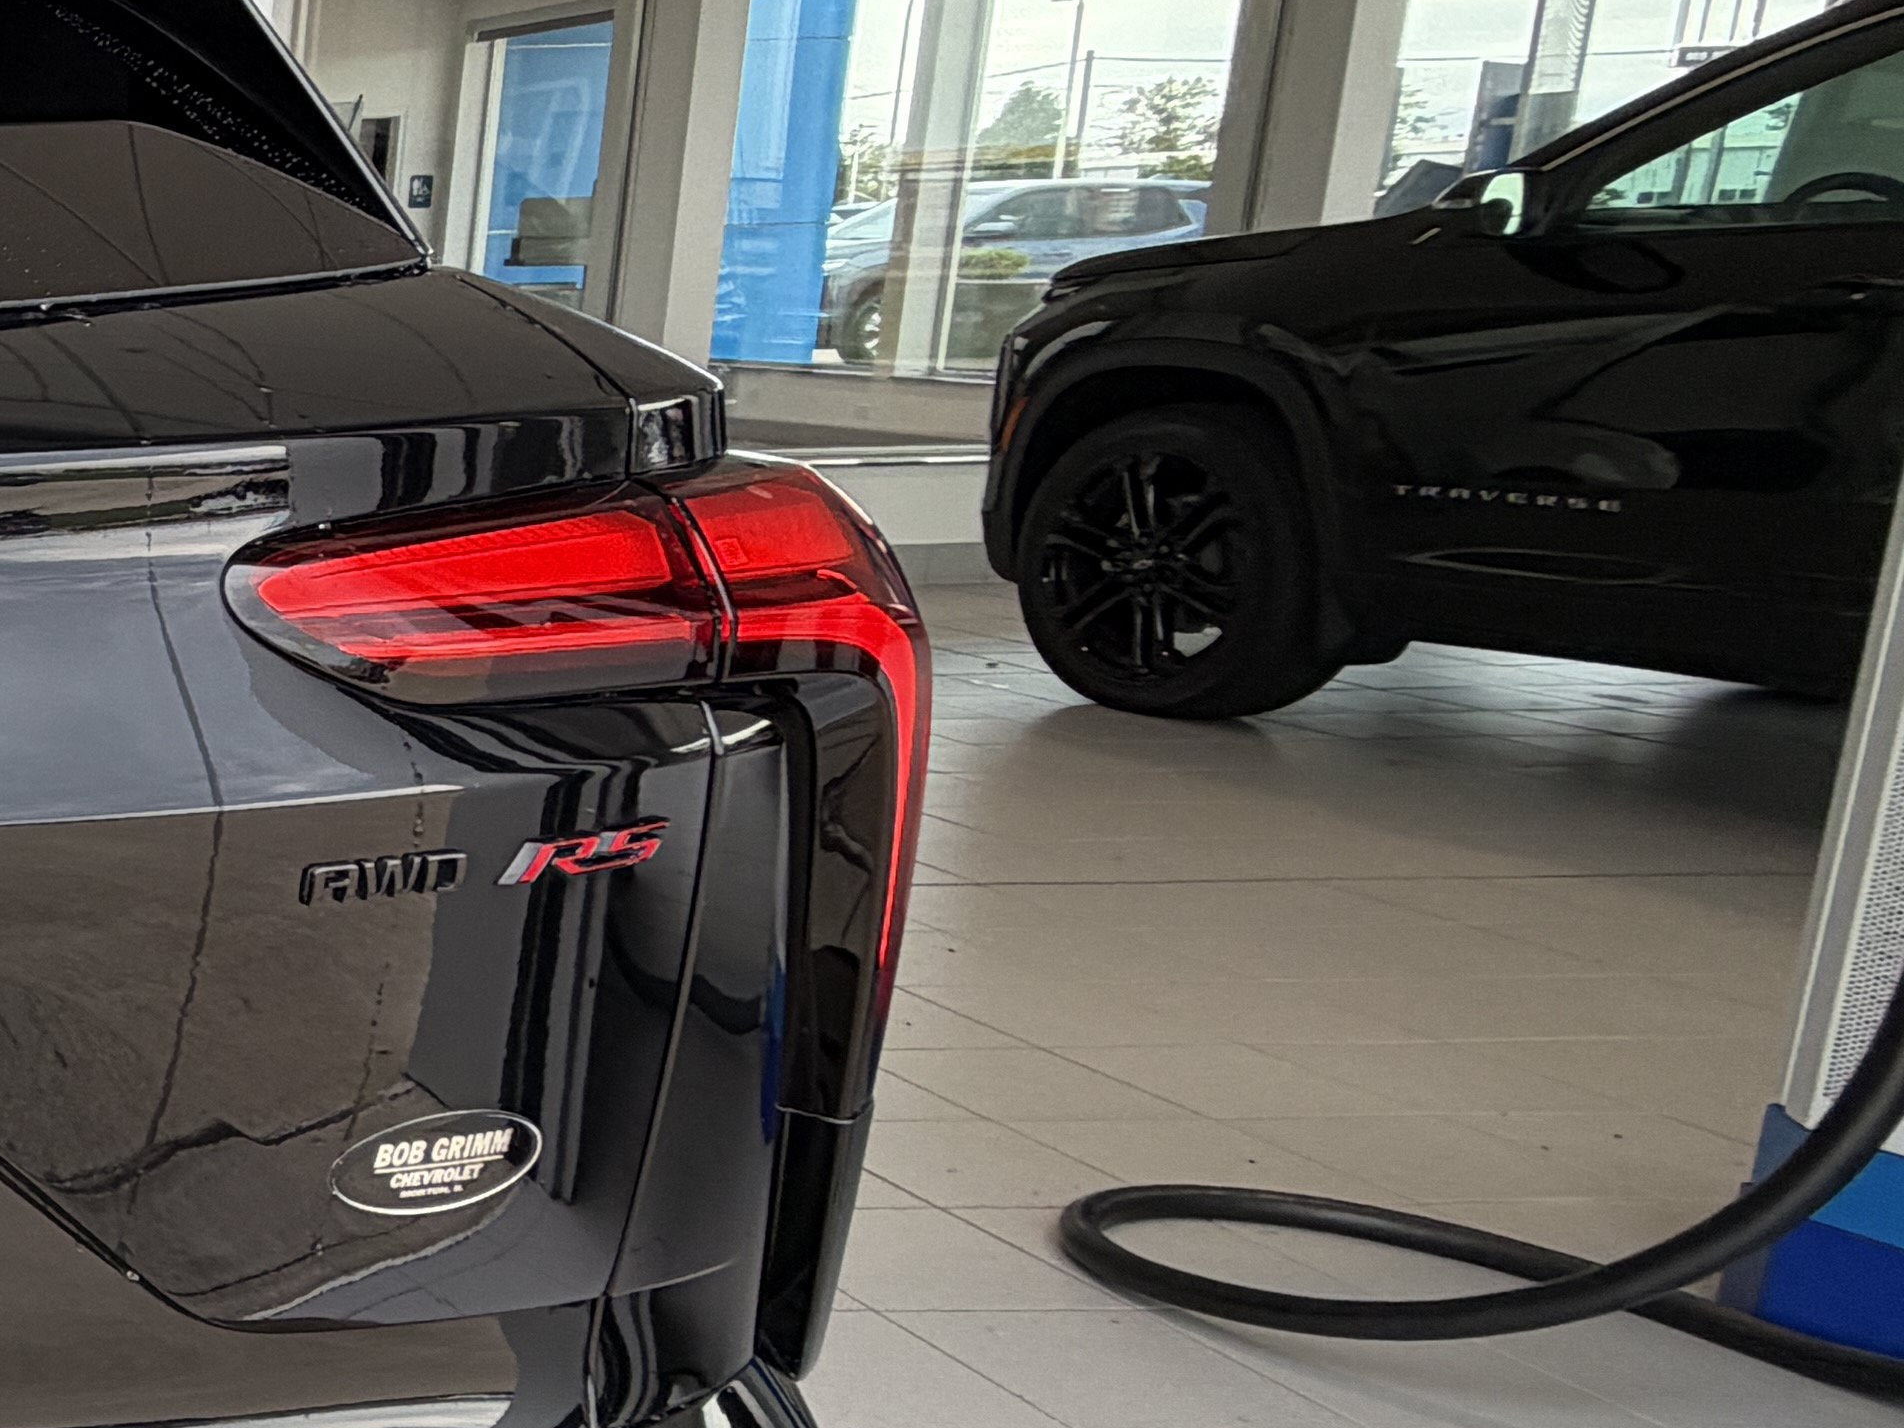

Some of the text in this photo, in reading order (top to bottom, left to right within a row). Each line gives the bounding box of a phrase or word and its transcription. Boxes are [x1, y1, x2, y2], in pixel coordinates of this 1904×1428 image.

[1393, 484, 1622, 513] TRAVERSE
[497, 816, 670, 885] RS
[299, 848, 466, 906] AWD
[373, 1127, 514, 1169] BOB GRIMM
[390, 1163, 484, 1189] CHEVROLET
